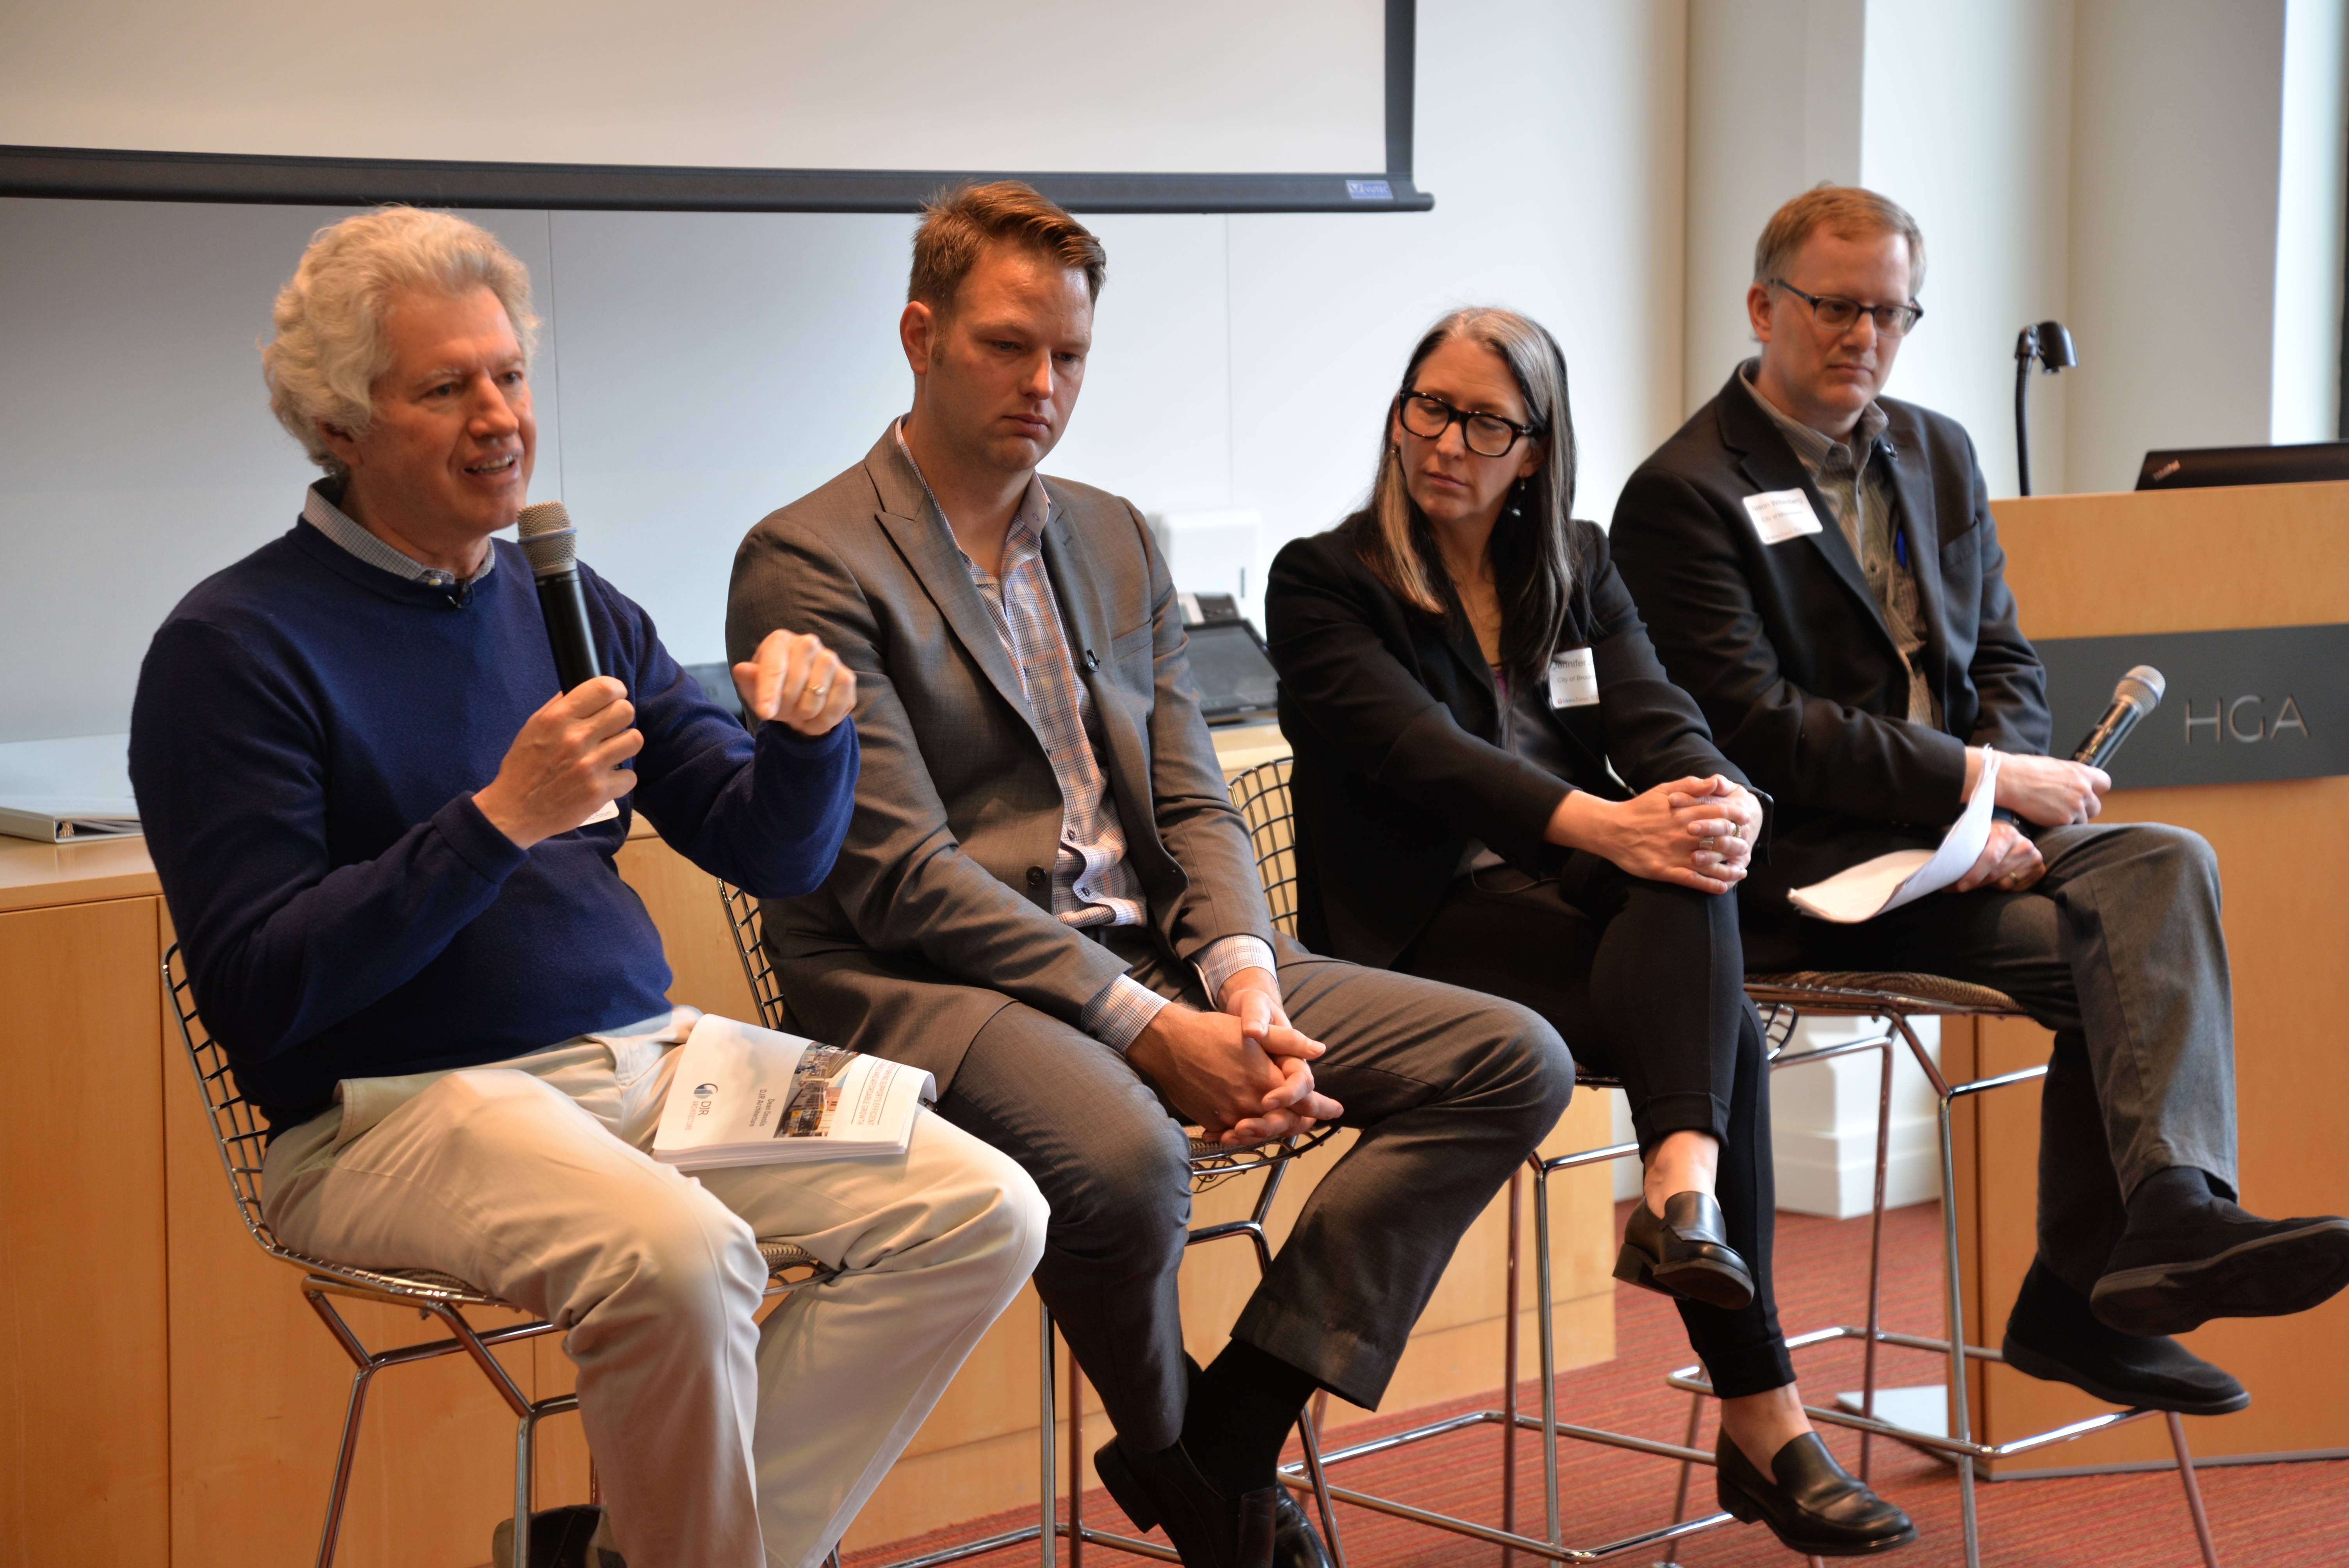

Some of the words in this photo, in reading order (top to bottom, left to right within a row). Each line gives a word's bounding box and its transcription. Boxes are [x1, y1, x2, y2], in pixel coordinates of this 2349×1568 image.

[1553, 659, 1586, 669] Jennifer
[2186, 693, 2310, 745] HGA
[757, 1089, 767, 1099] DJR
[863, 1078, 877, 1105] AFFORDABLE
[874, 1081, 888, 1102] SUPPORTS
[698, 1101, 711, 1115] DJR
[749, 1099, 764, 1127] Architecture
[765, 1099, 775, 1111] Dean
[857, 1105, 869, 1125] GROWTH
[867, 1103, 880, 1126] EFFICIENT
[684, 1101, 699, 1131] ARCHITECTURE
